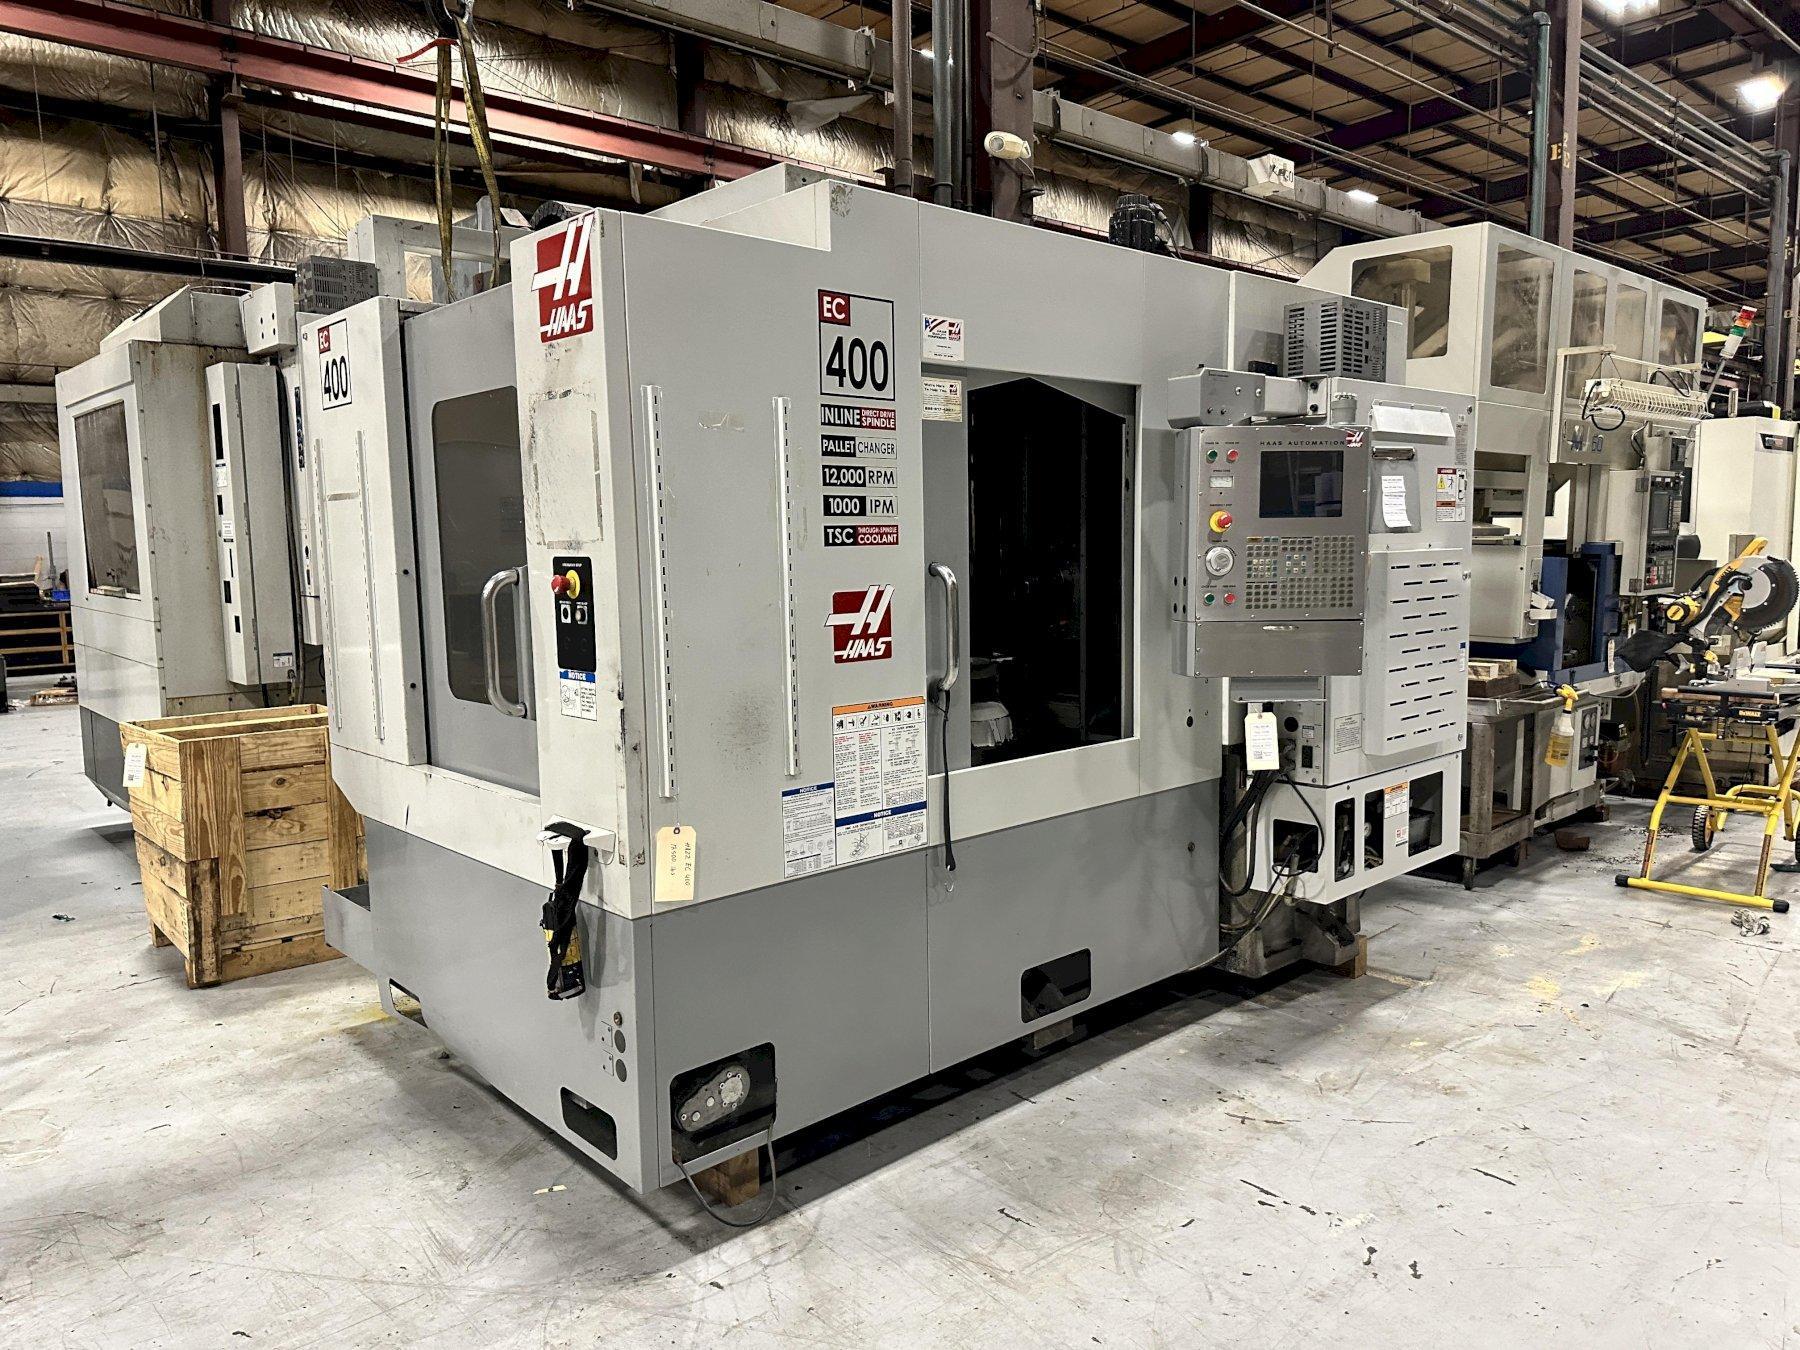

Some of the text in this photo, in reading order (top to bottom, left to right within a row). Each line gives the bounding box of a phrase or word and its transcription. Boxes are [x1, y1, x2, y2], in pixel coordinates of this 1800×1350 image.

[822, 296, 846, 320] EC
[540, 298, 592, 337] HAAS
[320, 330, 330, 349] EC
[825, 335, 889, 391] 400
[324, 355, 348, 402] 400
[821, 406, 895, 426] INLINE DIRECT DRIVE
[861, 417, 895, 428] SPINDLE
[822, 439, 895, 454] PALLET CHANGER
[824, 468, 895, 485] 12,000 RPM
[829, 497, 894, 514] 1000 IPM
[827, 527, 854, 544] TSC
[858, 534, 898, 544] COOLANT
[834, 636, 892, 660] HAAS
[567, 671, 587, 681] NOTICE
[873, 809, 892, 819] NOTICE
